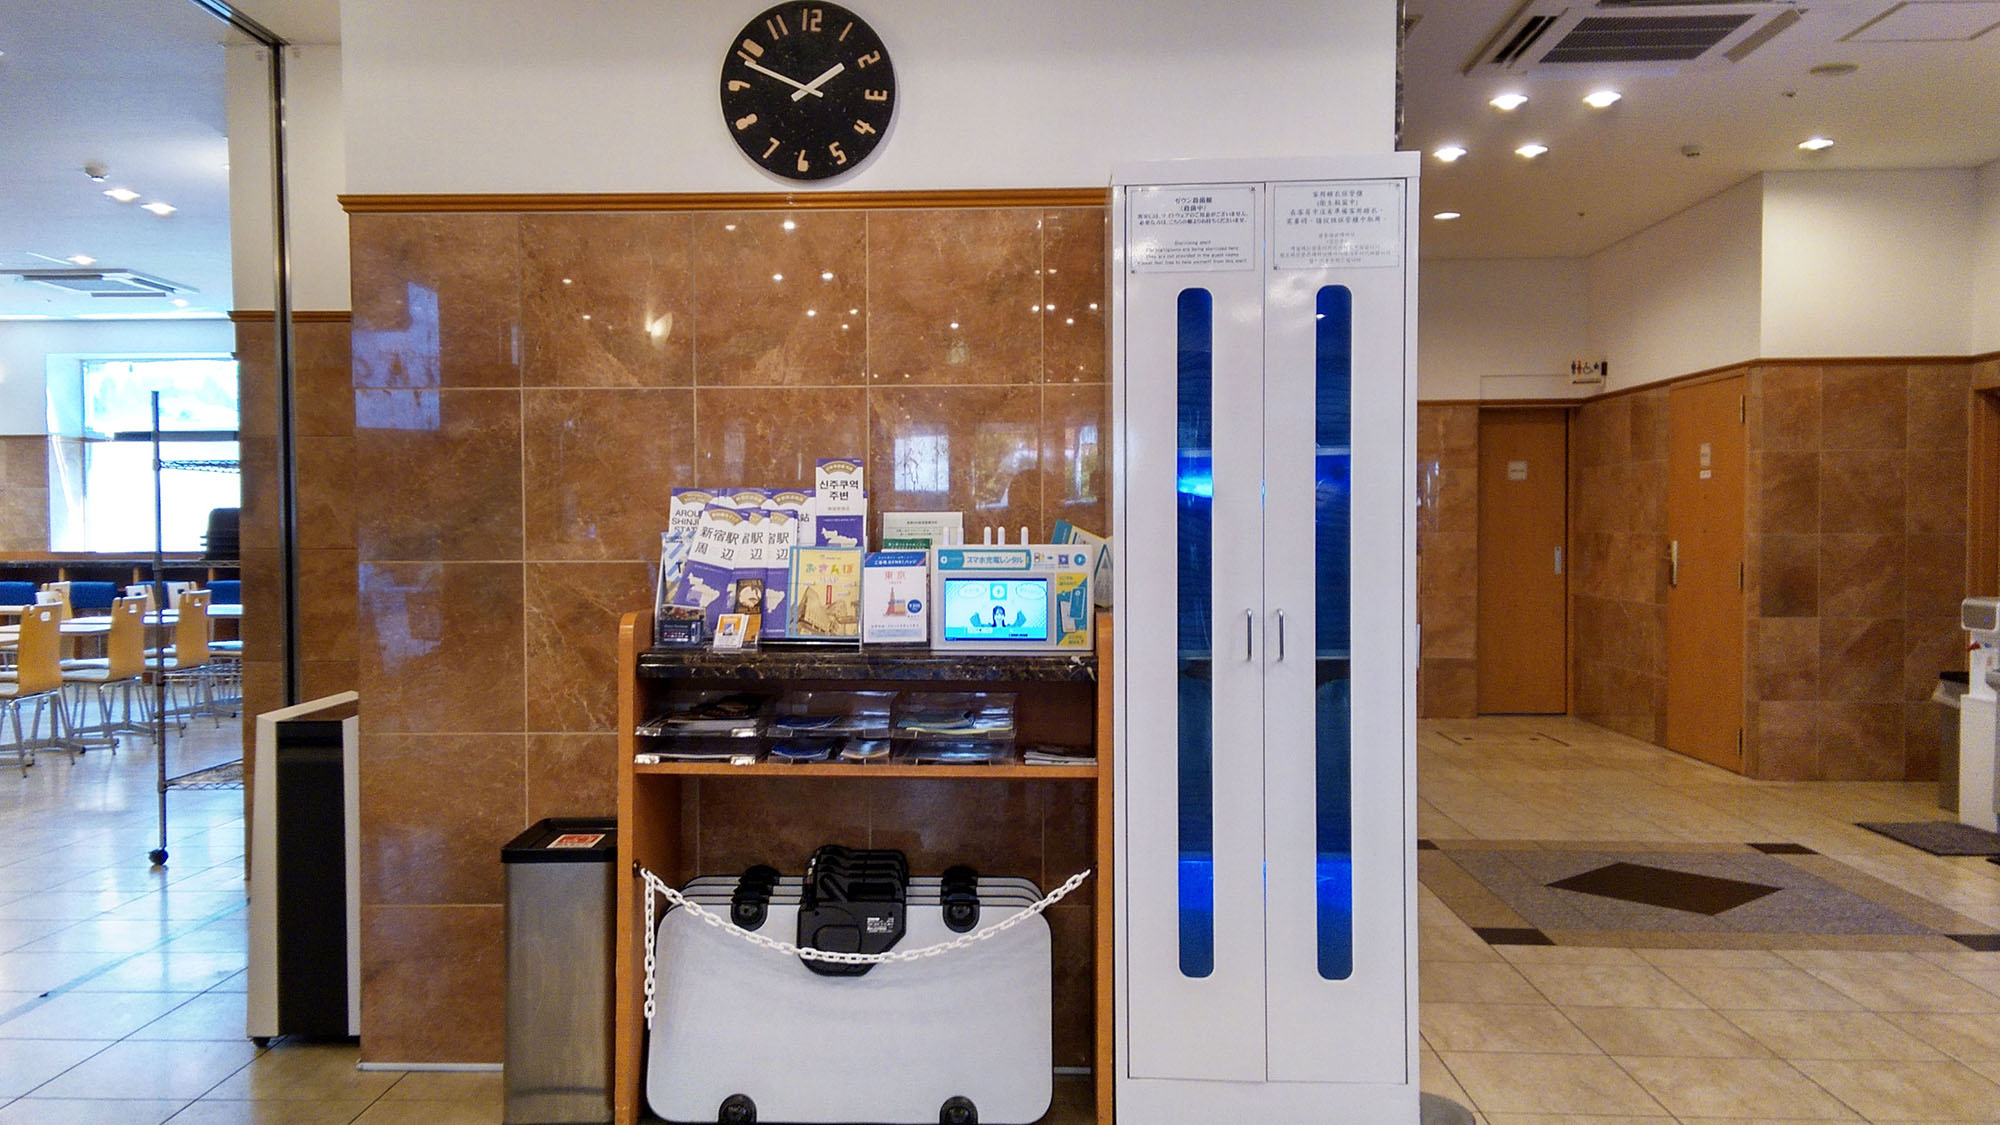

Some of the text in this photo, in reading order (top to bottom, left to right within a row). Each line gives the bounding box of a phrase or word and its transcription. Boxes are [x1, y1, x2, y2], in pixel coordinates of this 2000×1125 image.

[766, 14, 789, 41] 11
[802, 8, 823, 33] 12
[838, 22, 853, 42] 1
[737, 38, 764, 64] 10
[857, 49, 881, 69] 2
[727, 79, 751, 93] 9
[864, 88, 888, 102] 3
[735, 113, 758, 131] 8
[853, 119, 877, 135] 4
[762, 137, 781, 159] 7
[828, 141, 847, 165] 5
[797, 149, 809, 173] 6
[829, 491, 849, 501] 주변
[700, 526, 740, 545] 新宿駅
[966, 555, 1024, 565] スマホ充電レンタル
